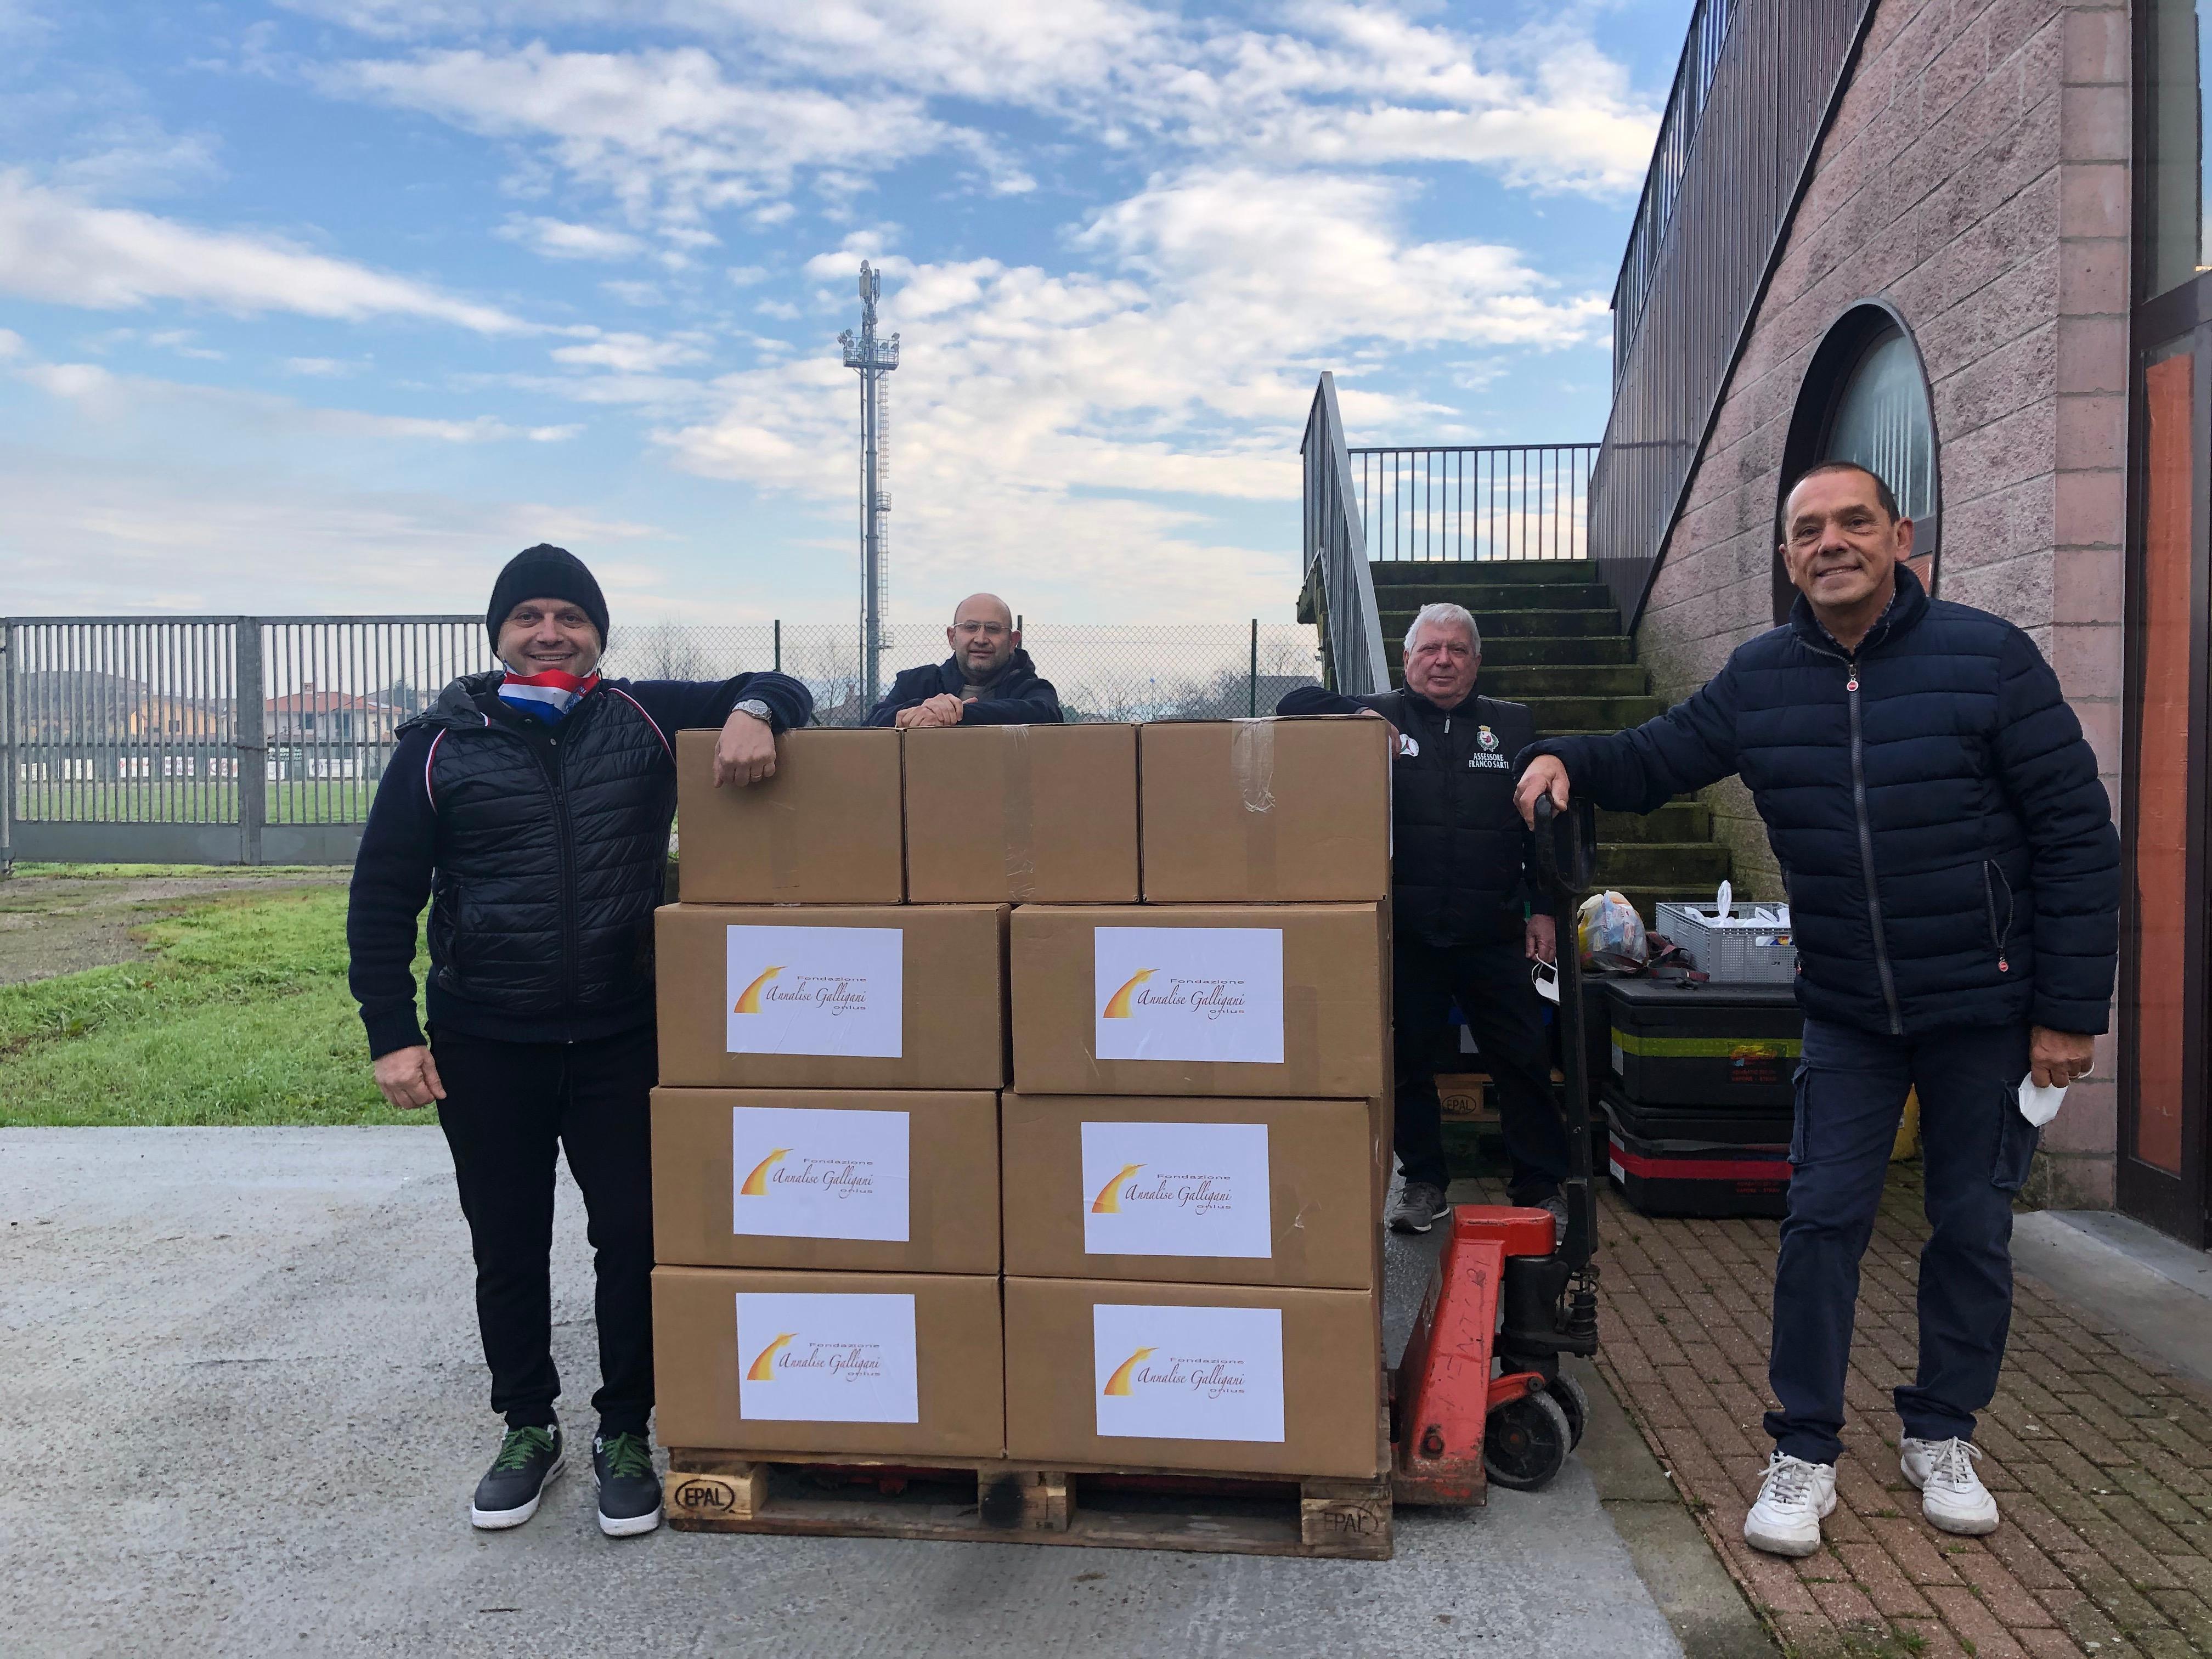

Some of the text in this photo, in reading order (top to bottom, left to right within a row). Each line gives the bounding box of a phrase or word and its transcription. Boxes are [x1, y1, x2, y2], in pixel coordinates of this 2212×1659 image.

[1469, 760, 1509, 769] FRANCO SARTI
[1473, 753, 1504, 761] ASSESSORE
[766, 981, 867, 1016] Annalise Galligani
[1137, 984, 1245, 1020] Annalise Galligani
[1447, 1099, 1471, 1111] EPAL
[772, 1164, 873, 1199] Annalise Galligani
[1125, 1180, 1232, 1215] Annalise Galligani
[778, 1348, 881, 1382] Annalise Galligani
[1137, 1363, 1245, 1400] Annalise Galligani
[685, 1487, 725, 1507] EPAL
